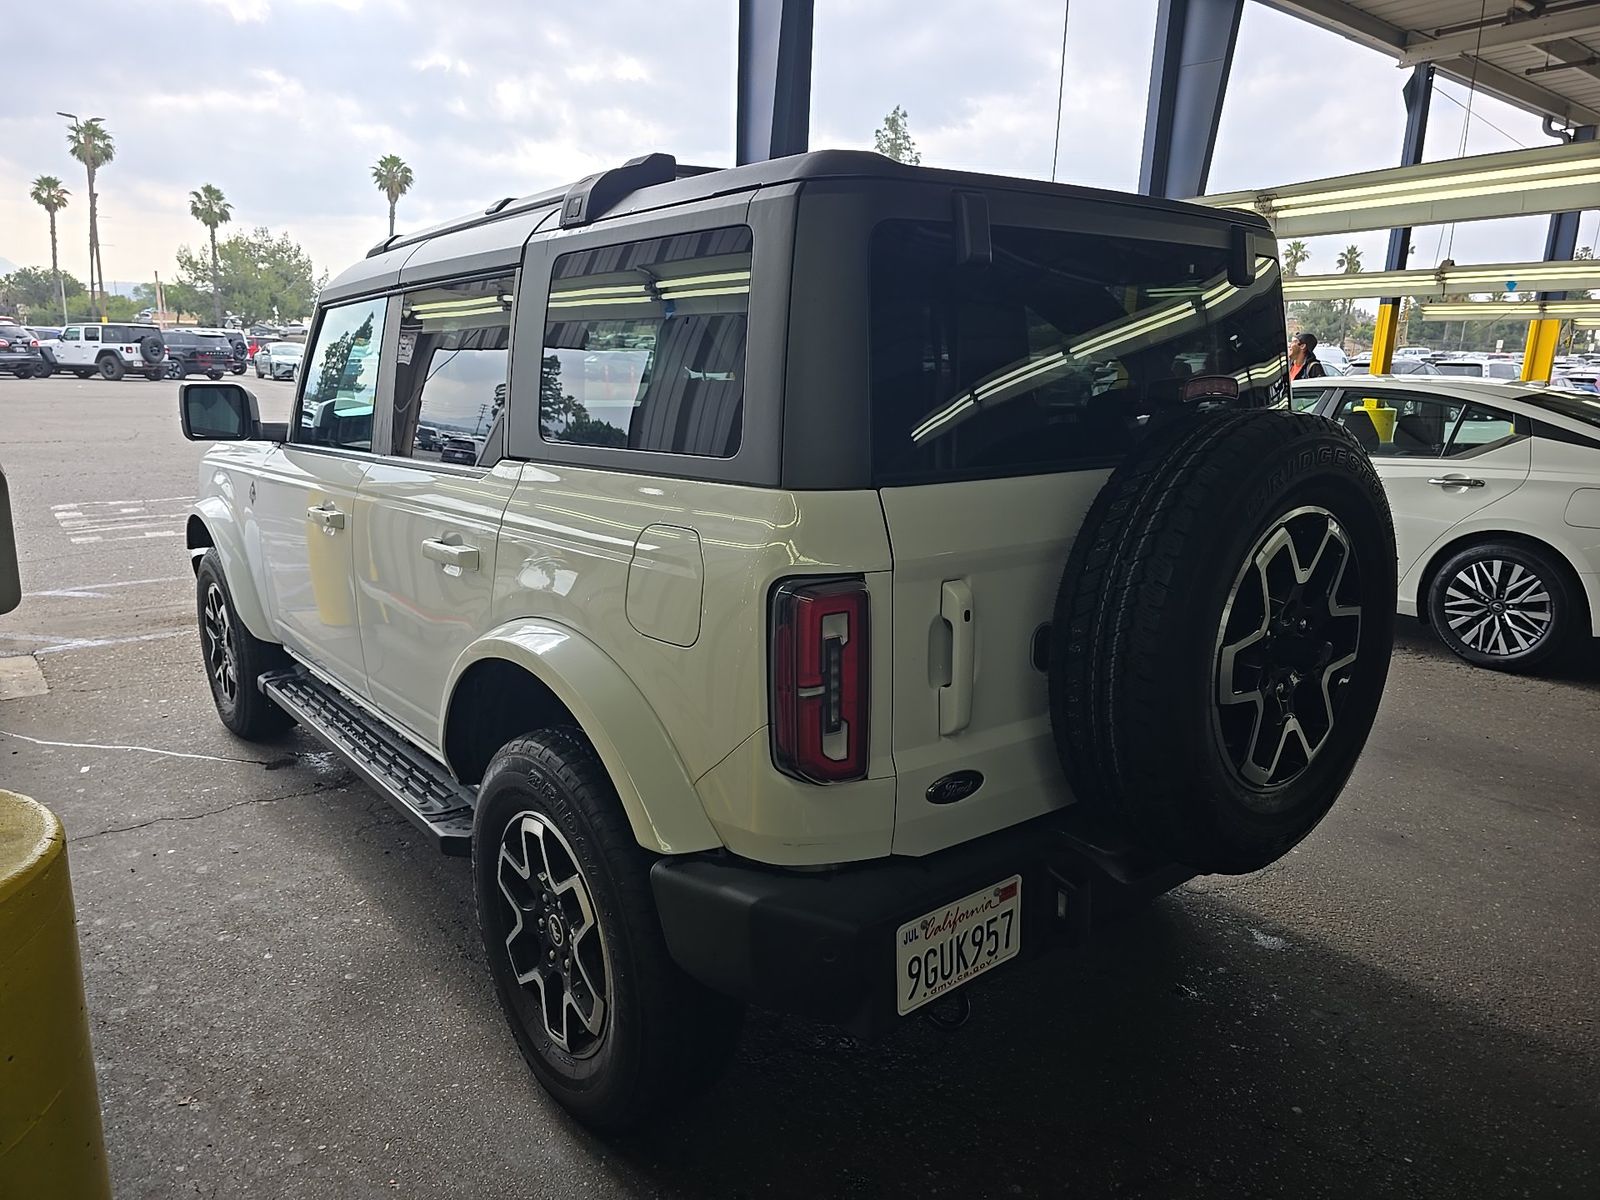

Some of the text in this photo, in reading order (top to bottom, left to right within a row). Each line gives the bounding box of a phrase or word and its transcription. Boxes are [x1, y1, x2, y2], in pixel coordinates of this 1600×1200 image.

[903, 928, 919, 945] JUL
[924, 897, 999, 940] California
[908, 909, 1014, 1000] 9GUK957
[930, 960, 992, 995] dmv.ca.gov
